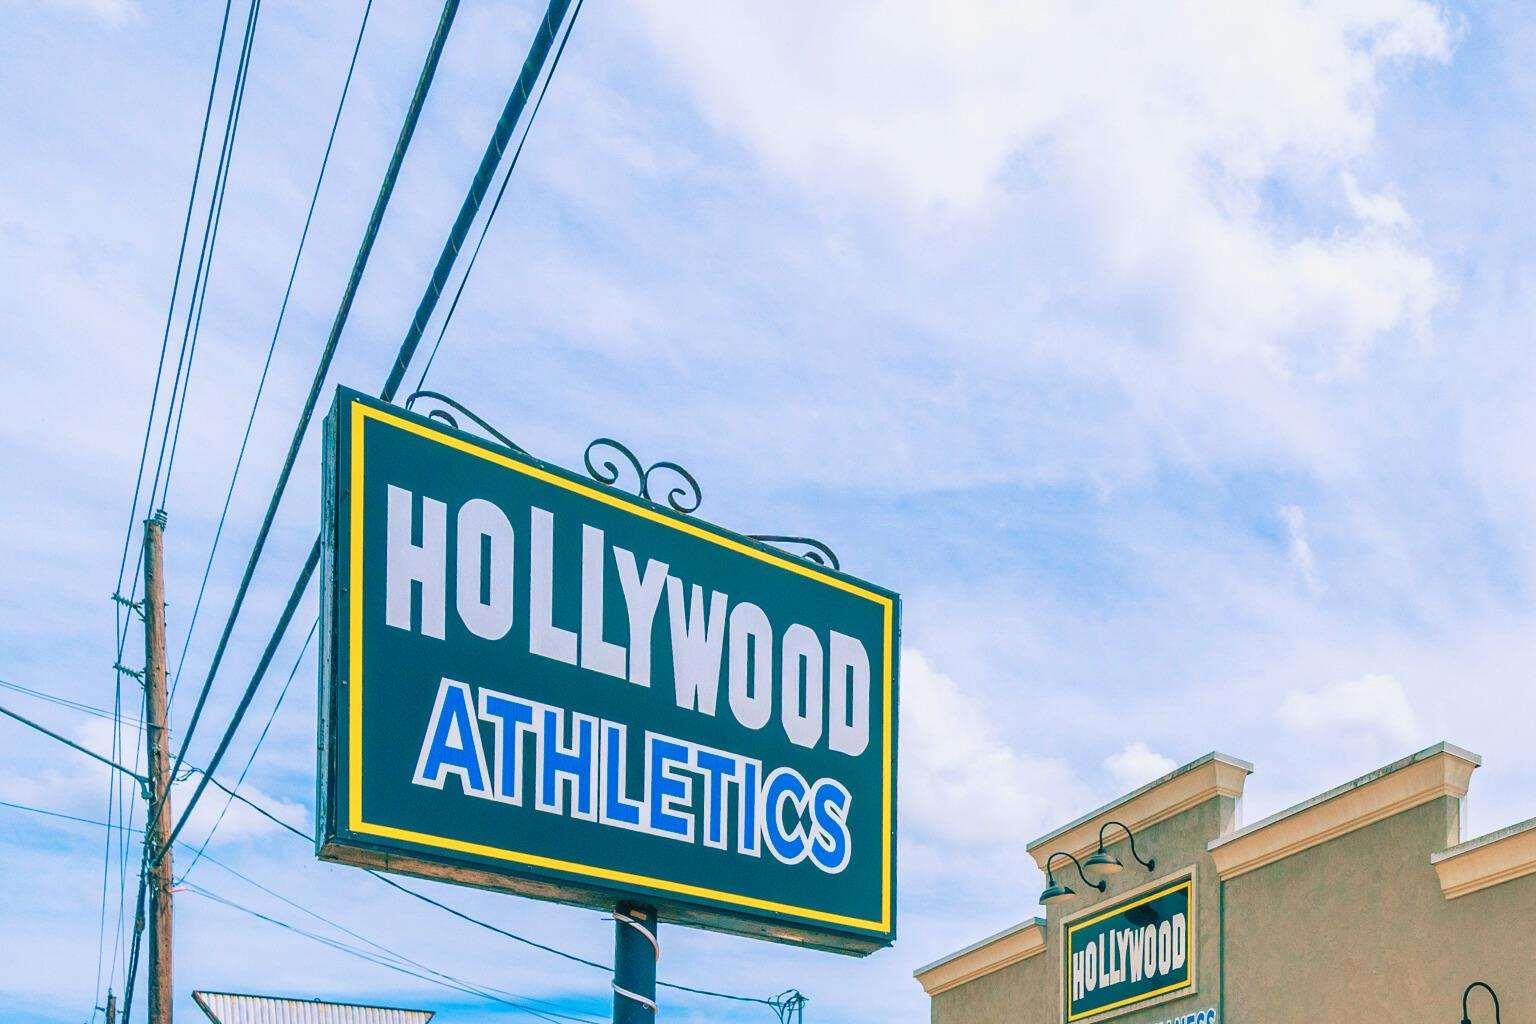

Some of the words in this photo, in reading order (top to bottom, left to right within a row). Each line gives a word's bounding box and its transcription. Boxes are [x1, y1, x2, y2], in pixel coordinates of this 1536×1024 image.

[385, 483, 870, 758] HOLLYWOOD
[411, 677, 852, 875] ATHLETICS
[1072, 912, 1186, 1001] HOLLYWOOD
